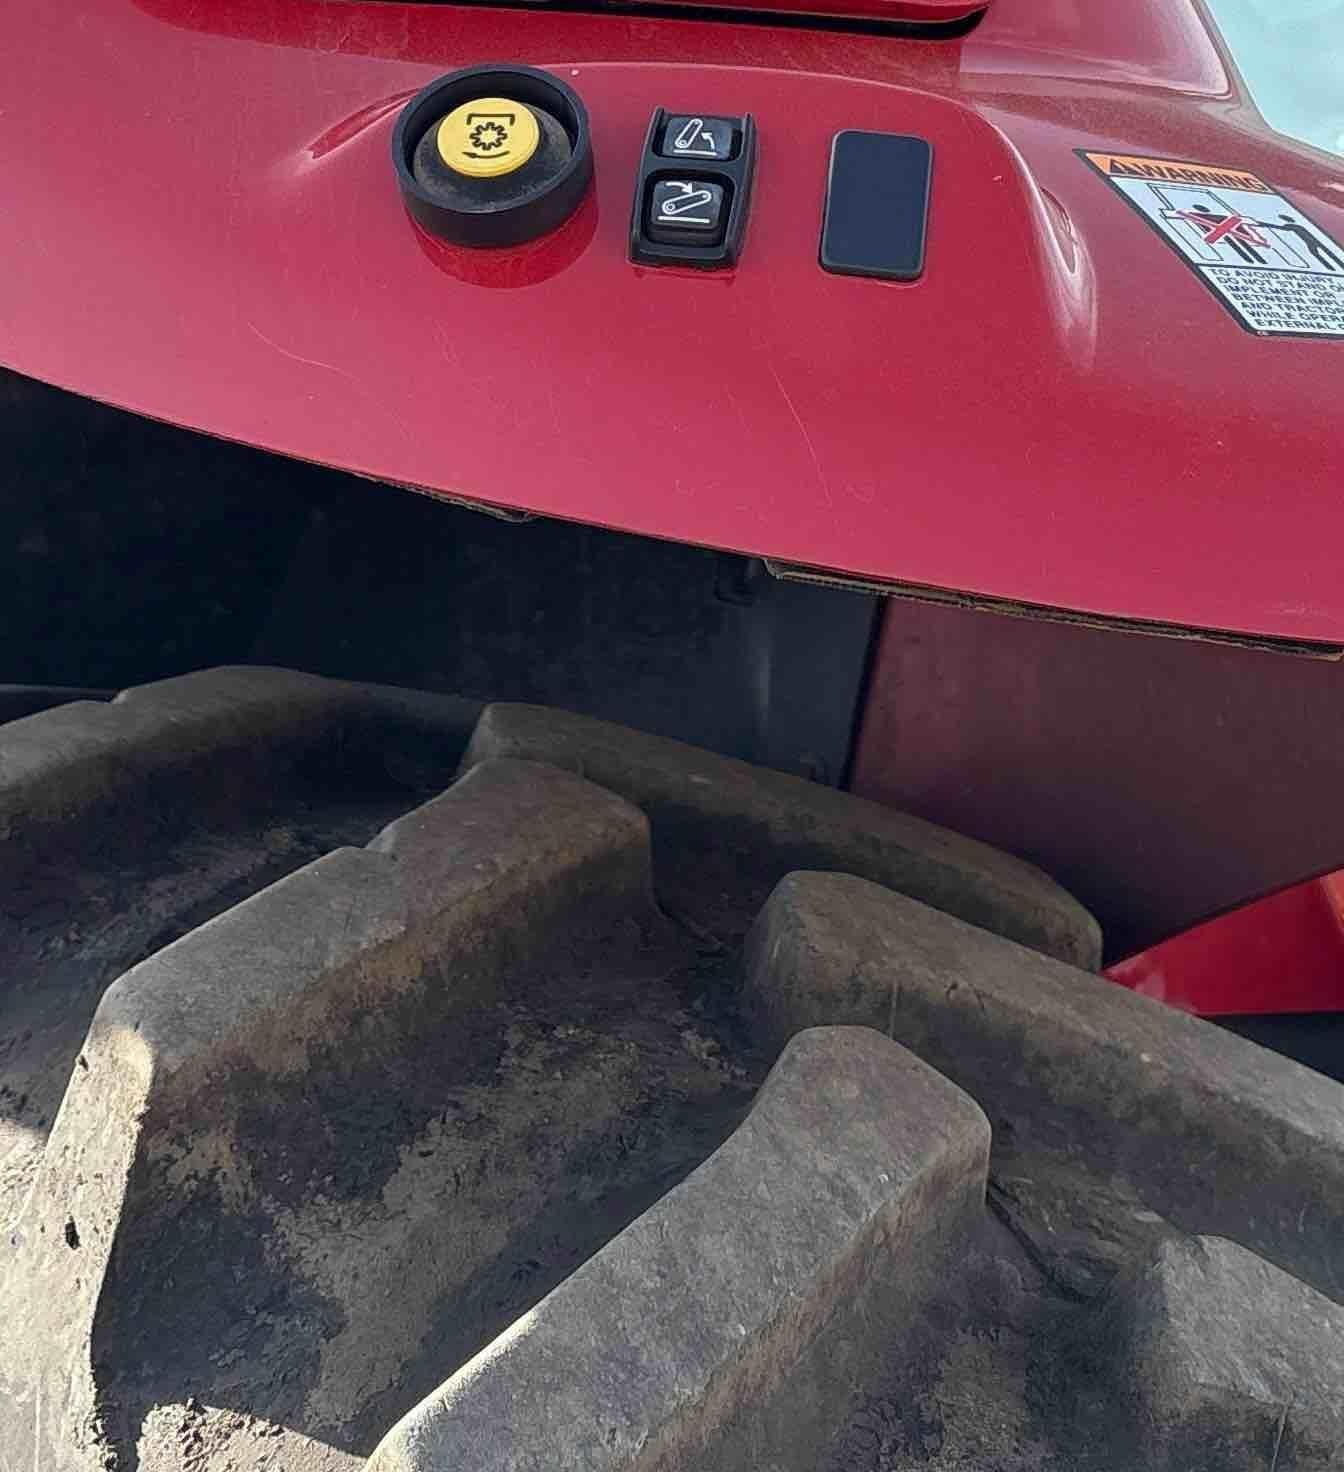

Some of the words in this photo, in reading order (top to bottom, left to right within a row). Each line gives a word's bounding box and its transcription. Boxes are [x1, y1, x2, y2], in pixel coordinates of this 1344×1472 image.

[1137, 162, 1270, 193] WARNING
[1207, 268, 1233, 276] TO
[1231, 270, 1282, 280] AVOID
[1214, 276, 1241, 284] DO
[1240, 277, 1275, 287] NOT
[1274, 280, 1328, 290] STAND
[1222, 284, 1310, 297] IMPLEMENT
[1310, 290, 1338, 299] OR
[1229, 292, 1308, 305] BETWEEN
[1237, 300, 1274, 310] AND
[1244, 309, 1299, 320] WHILE
[1252, 317, 1338, 331] EXTERNAL
